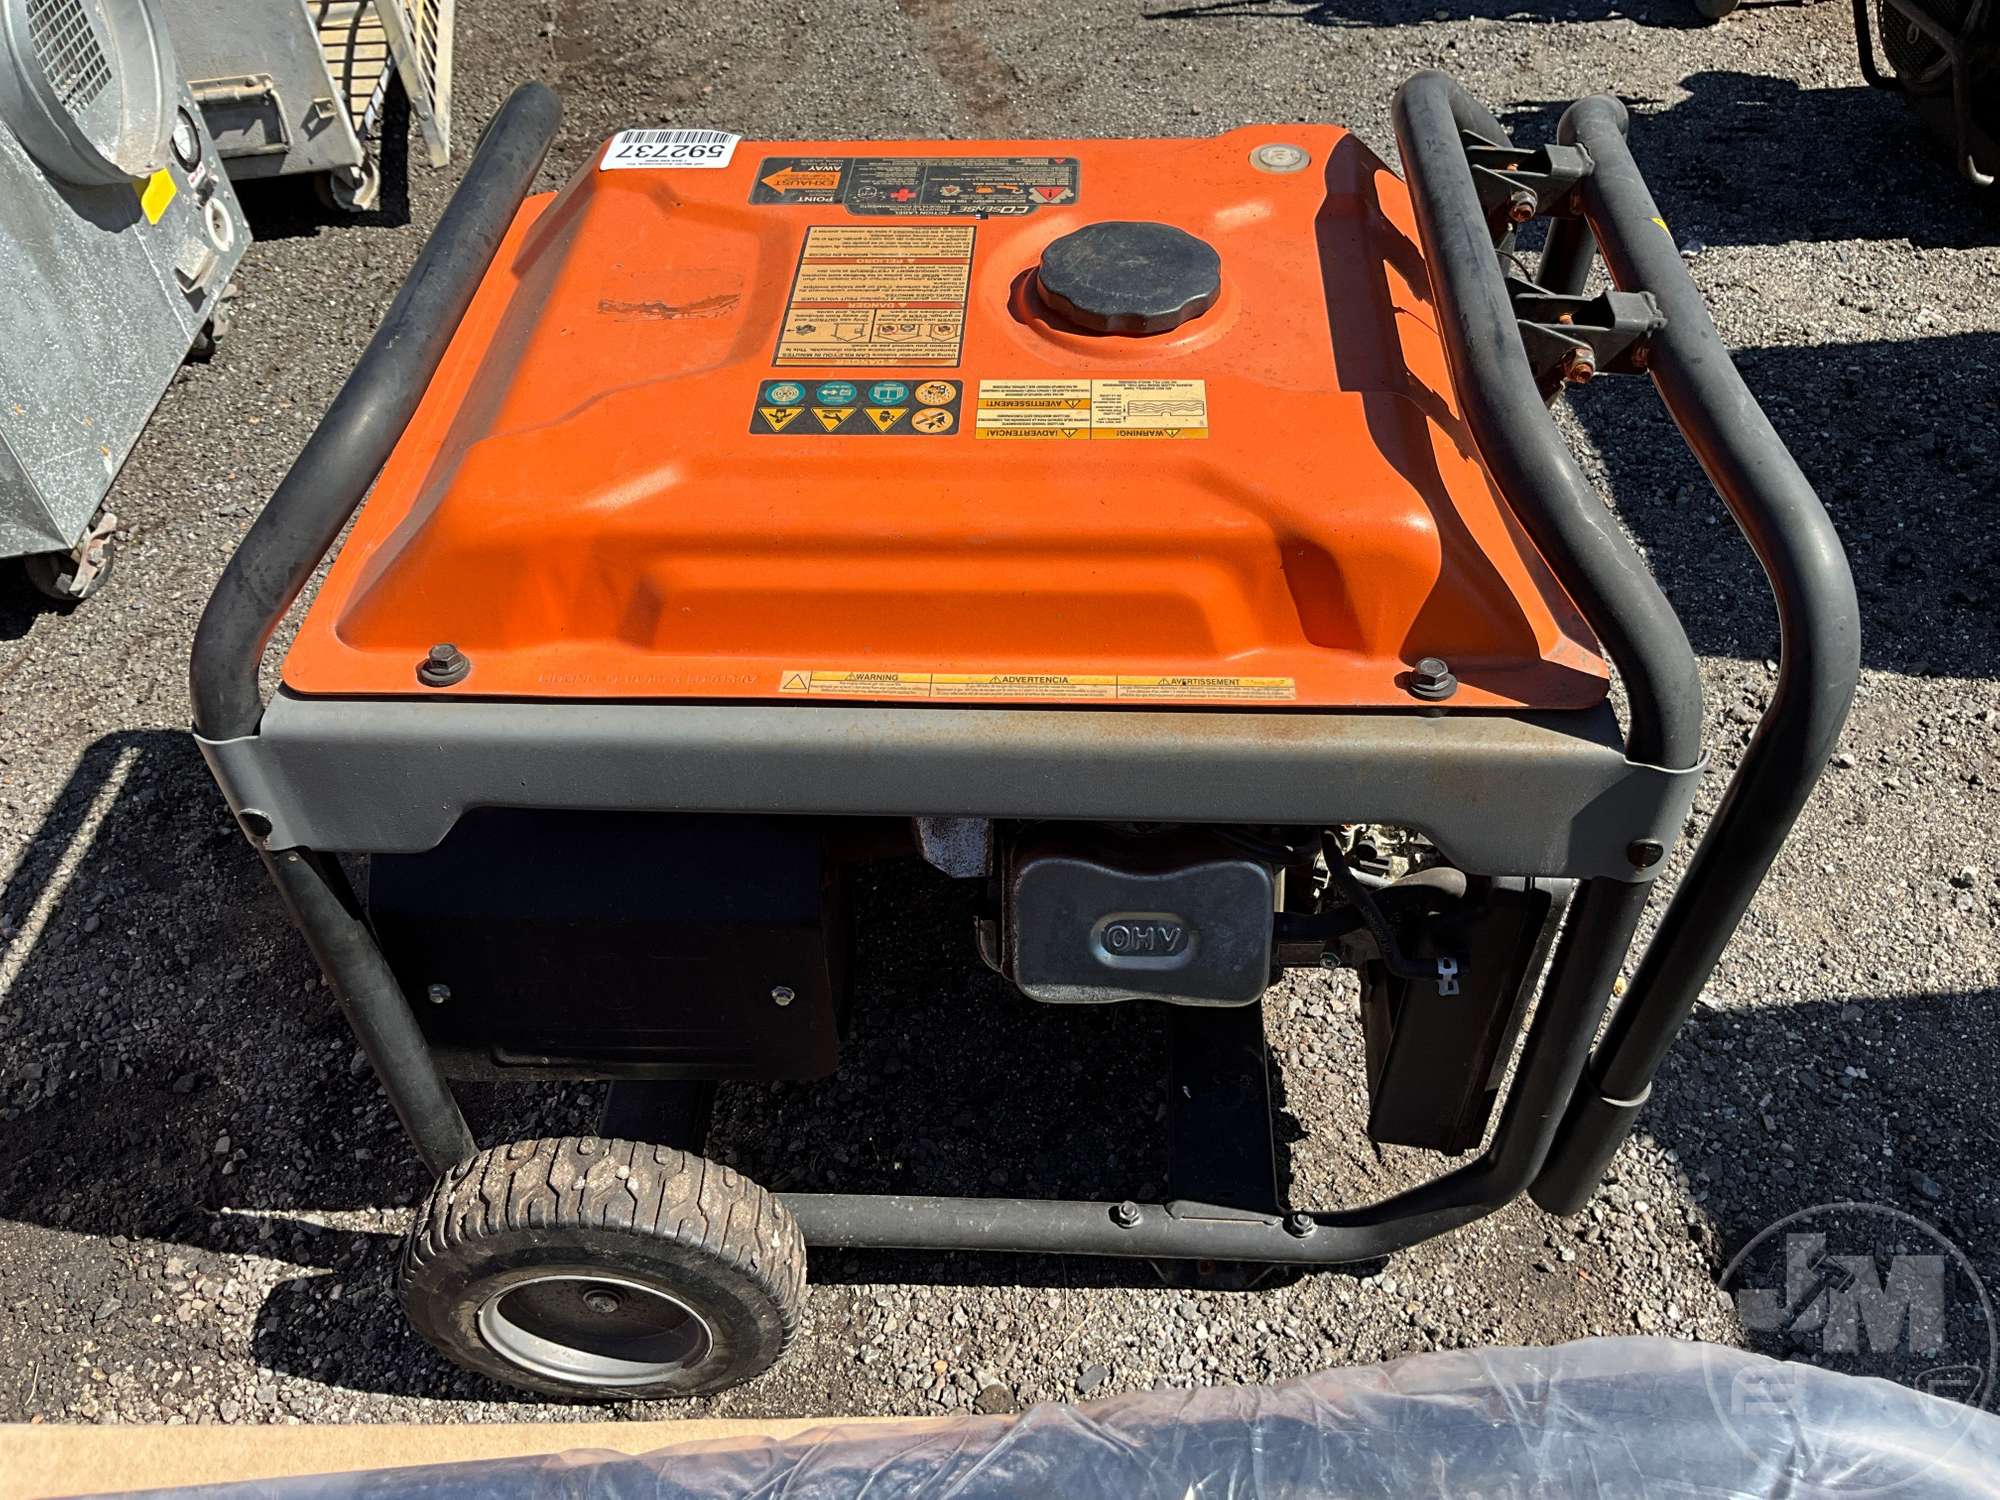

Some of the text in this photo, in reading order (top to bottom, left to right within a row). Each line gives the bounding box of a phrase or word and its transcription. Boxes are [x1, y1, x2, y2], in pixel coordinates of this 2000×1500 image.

[615, 145, 725, 158] 592737
[856, 673, 898, 681] WARNING
[1002, 676, 1068, 684] ADVERTENCIA
[1171, 678, 1240, 686] AVERTISSEMENT
[1106, 925, 1181, 951] OHV
